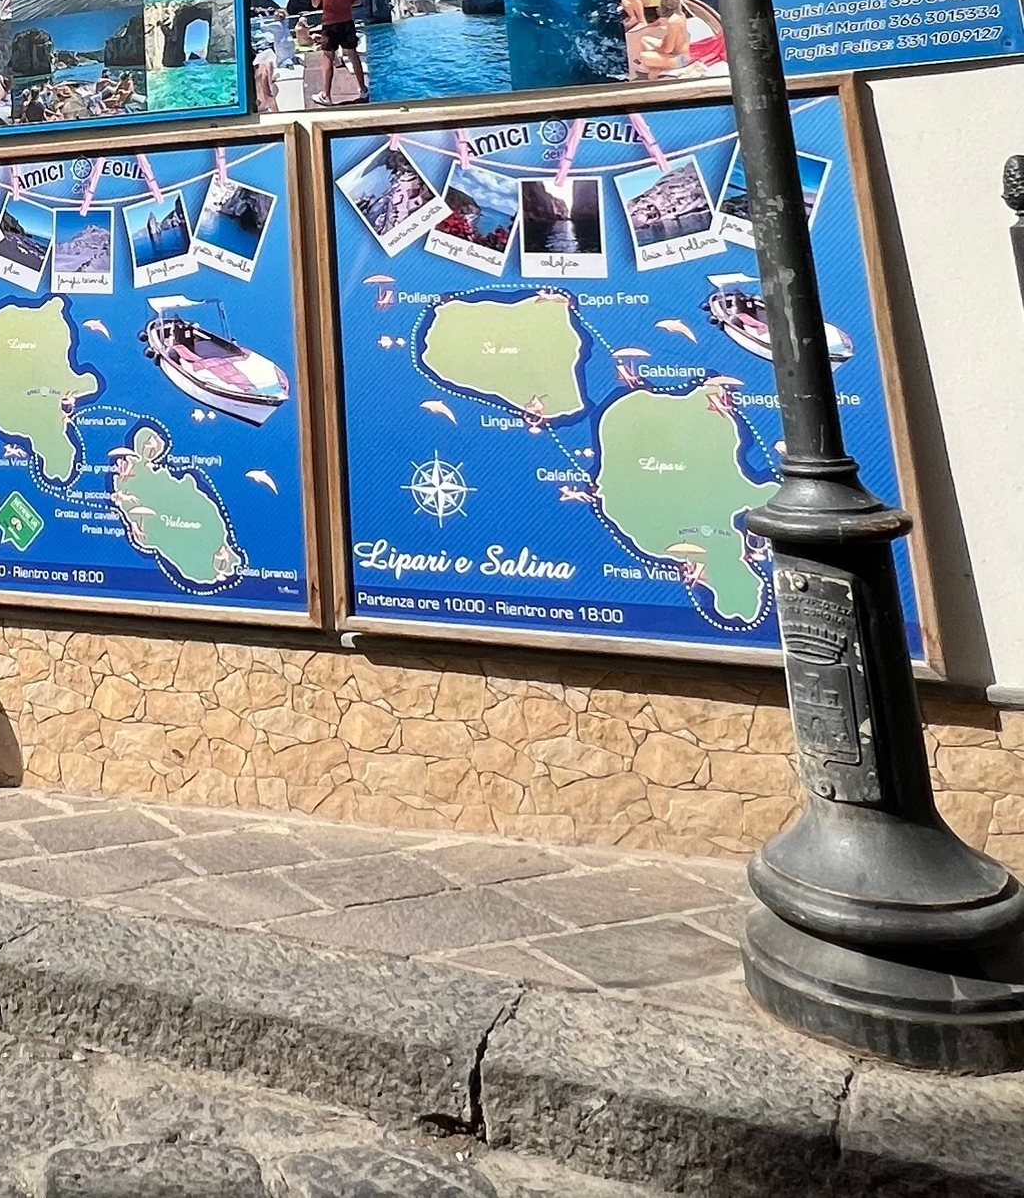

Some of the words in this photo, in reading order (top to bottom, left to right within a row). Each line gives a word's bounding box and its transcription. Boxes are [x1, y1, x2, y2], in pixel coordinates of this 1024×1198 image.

[780, 24, 832, 40] Puglisi
[835, 19, 885, 34] Mario:
[889, 13, 921, 29] 366
[925, 6, 1000, 24] 3015334
[785, 44, 837, 61] Puglisi
[841, 39, 894, 54] Felice:
[897, 34, 927, 49] 331
[933, 27, 1003, 45] 1009127
[388, 222, 419, 248] marina
[398, 291, 441, 304] Pollara
[577, 292, 613, 307] Capo
[616, 291, 650, 305] Faro
[638, 364, 706, 378] Gabbiano
[76, 416, 104, 426] Marina
[105, 416, 127, 426] Corta
[480, 414, 525, 431] Lingua
[75, 462, 93, 472] Cala
[638, 456, 686, 475] Lipari
[54, 508, 79, 519] Grotta
[160, 514, 202, 528] Vulcano
[353, 538, 452, 580] Lipari
[454, 558, 473, 574] e
[479, 544, 576, 579] Salina
[13, 566, 50, 580] Rientro
[51, 570, 69, 581] ore
[72, 569, 104, 584] 18:00
[603, 564, 642, 579] Praia
[644, 565, 681, 581] Vinci
[357, 591, 415, 609] Partenza
[417, 598, 440, 611] ore
[444, 598, 486, 614] 10:00
[495, 602, 546, 618] Rientro
[549, 607, 574, 620] ore
[578, 606, 624, 624] 18:00
